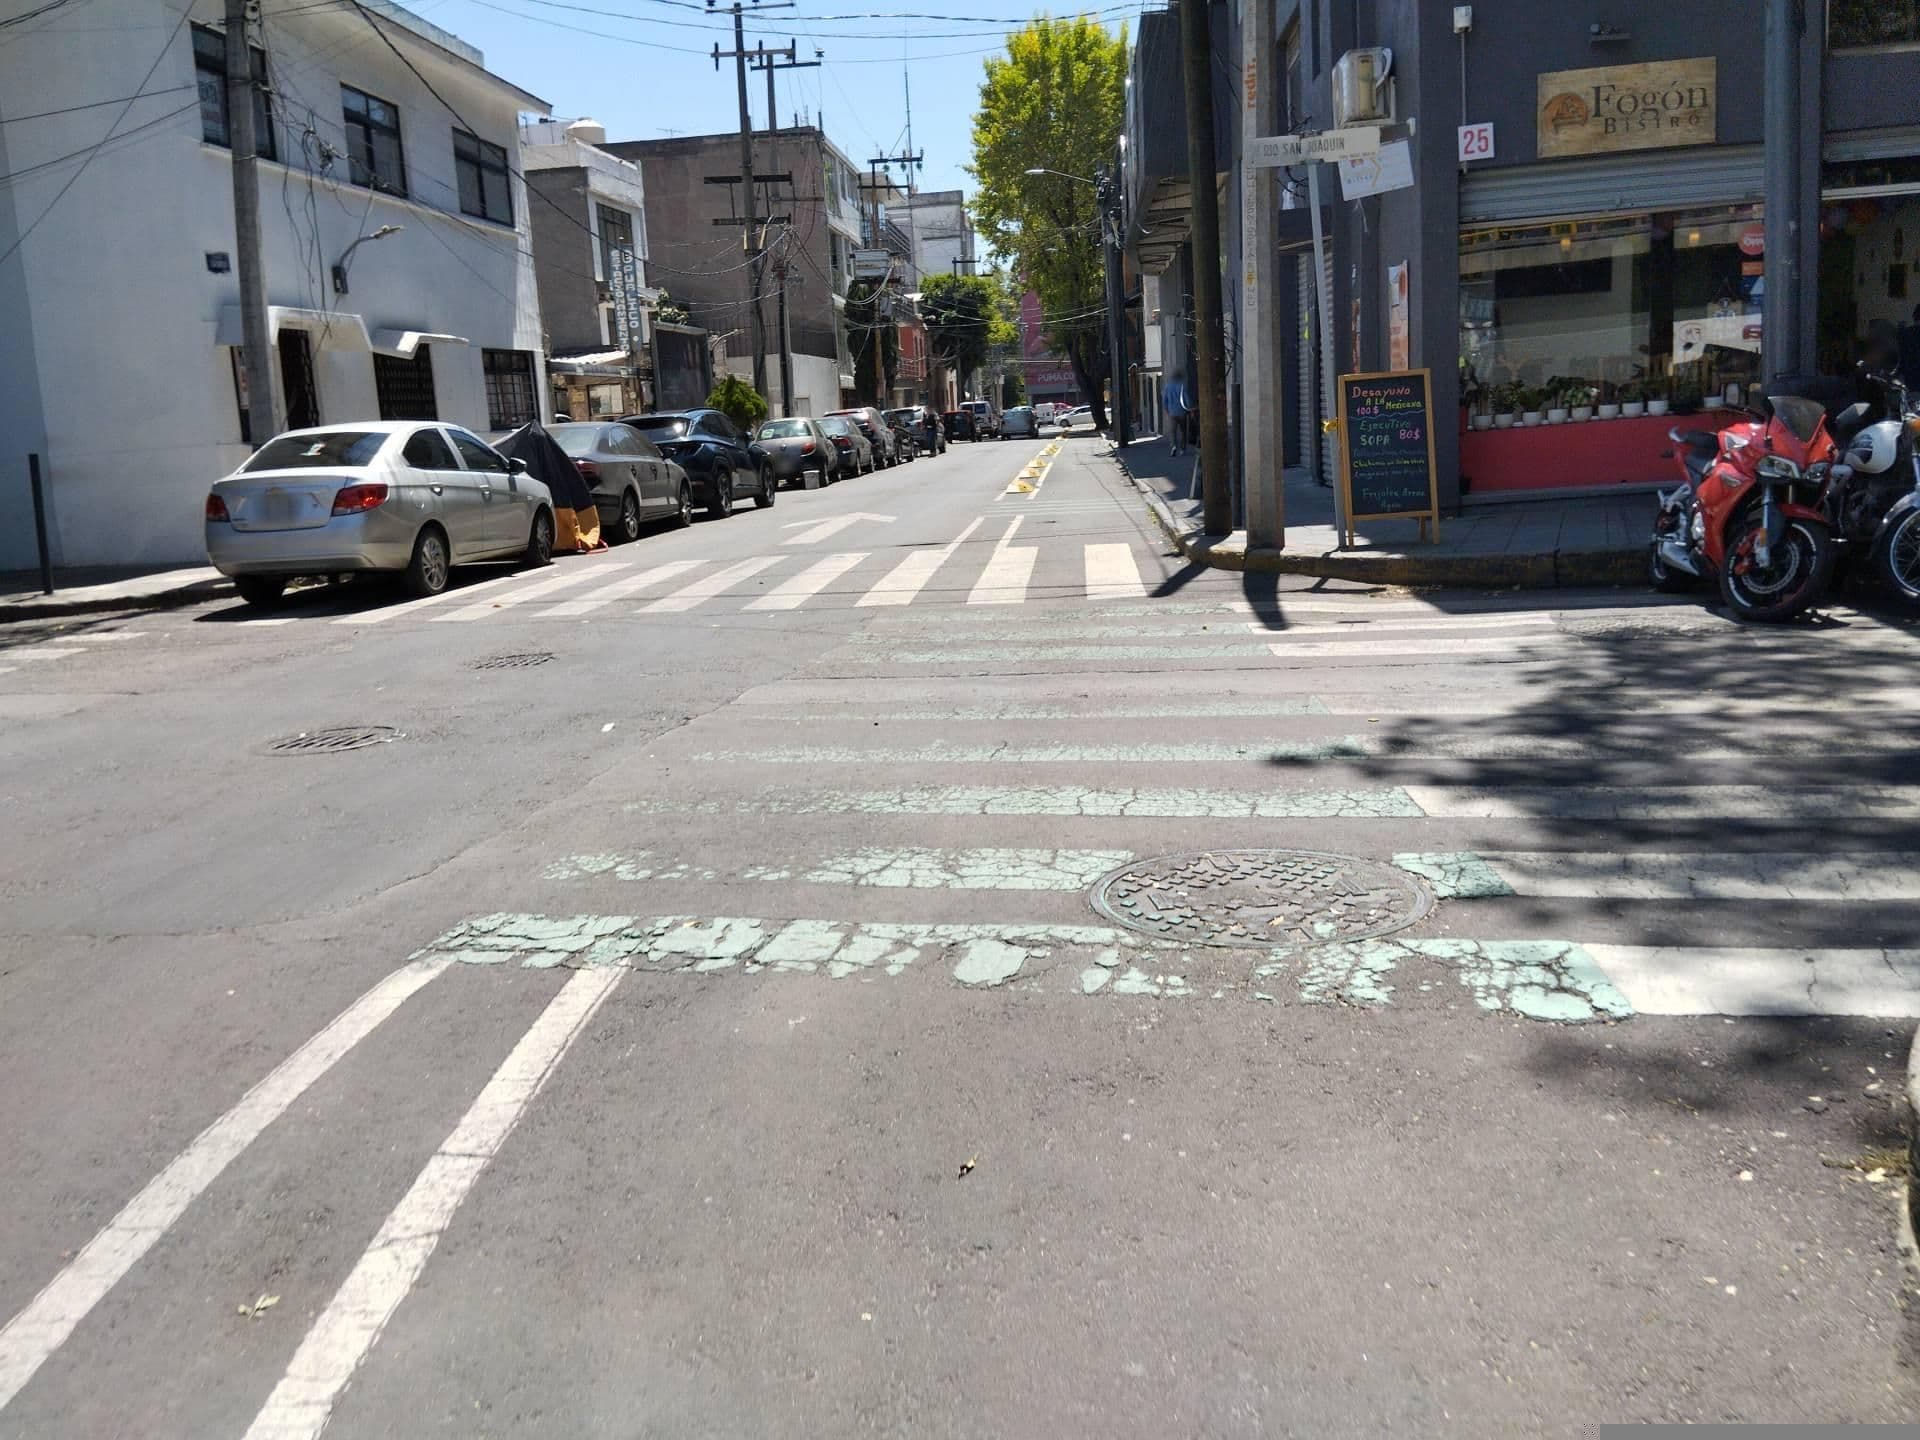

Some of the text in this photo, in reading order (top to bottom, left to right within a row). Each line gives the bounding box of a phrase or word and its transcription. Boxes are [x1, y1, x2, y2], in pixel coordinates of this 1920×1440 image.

[1592, 81, 1709, 119] Fogón
[1283, 143, 1302, 154] SAN
[1463, 128, 1489, 155] 25
